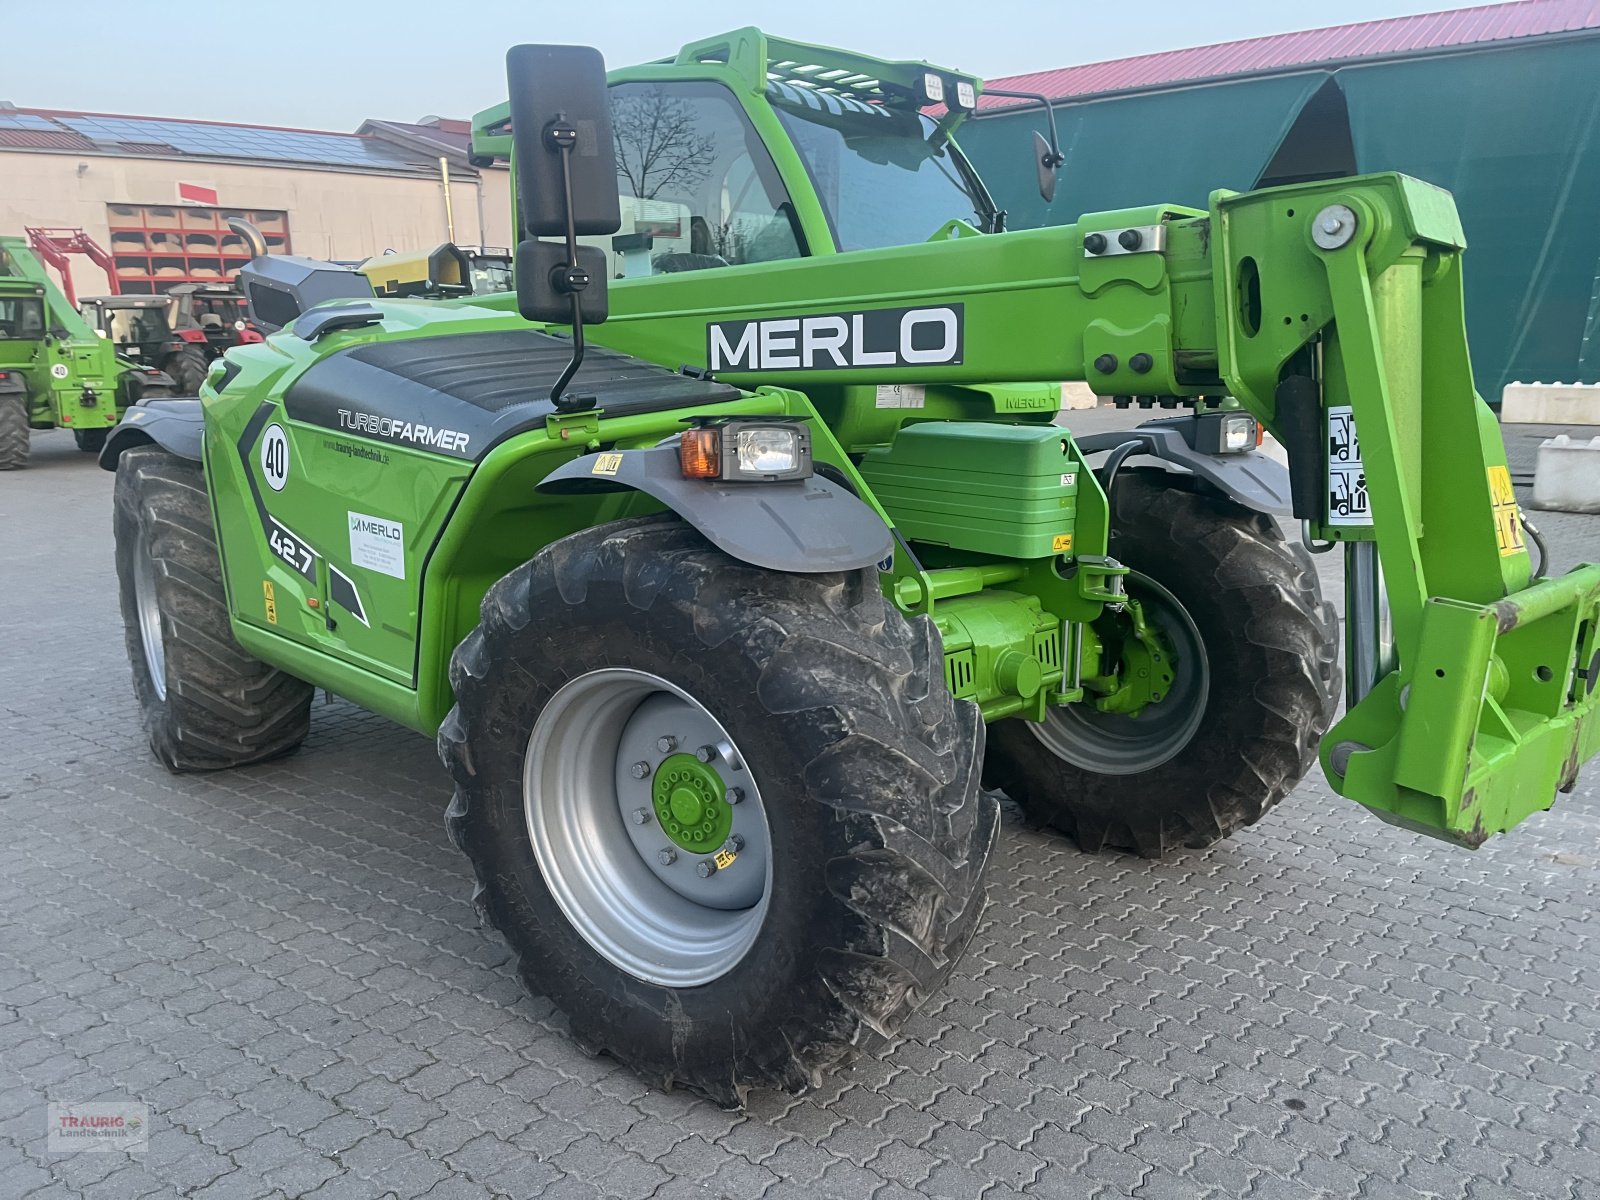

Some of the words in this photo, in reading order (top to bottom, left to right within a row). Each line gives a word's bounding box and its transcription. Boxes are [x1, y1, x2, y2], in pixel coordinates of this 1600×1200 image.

[710, 307, 958, 371] MERLO
[54, 366, 66, 376] 40
[1005, 397, 1048, 409] MERLO
[337, 408, 470, 453] TURBOFARMER
[265, 437, 284, 479] 40
[269, 529, 313, 574] 42.7
[362, 520, 401, 541] MERLO
